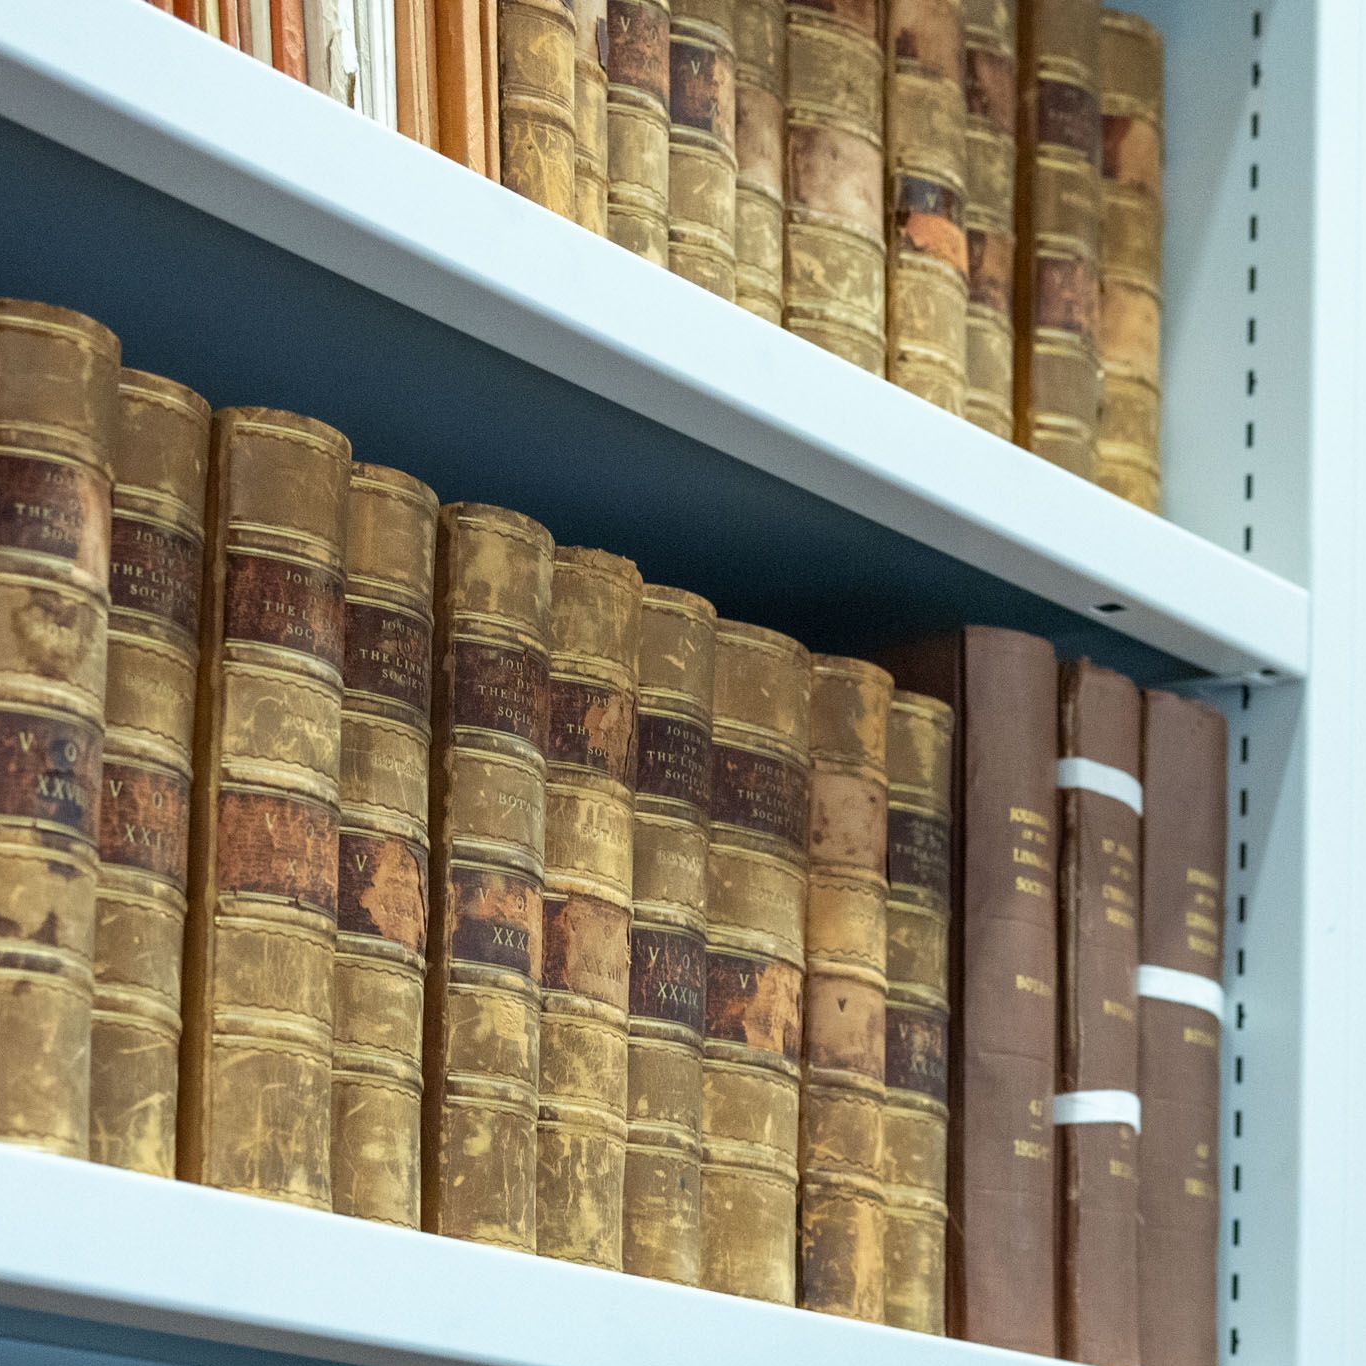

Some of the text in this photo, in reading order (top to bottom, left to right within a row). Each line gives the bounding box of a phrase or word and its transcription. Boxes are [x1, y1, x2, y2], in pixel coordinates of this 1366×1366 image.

[263, 601, 295, 616] THE
[359, 648, 391, 665] THE
[478, 684, 509, 698] THE
[19, 731, 77, 762] V O
[647, 750, 675, 763] THE
[110, 779, 163, 810] V O
[737, 788, 762, 802] THE
[355, 855, 367, 872] V
[479, 887, 490, 902] V
[648, 946, 660, 962] V
[740, 973, 750, 989] V
